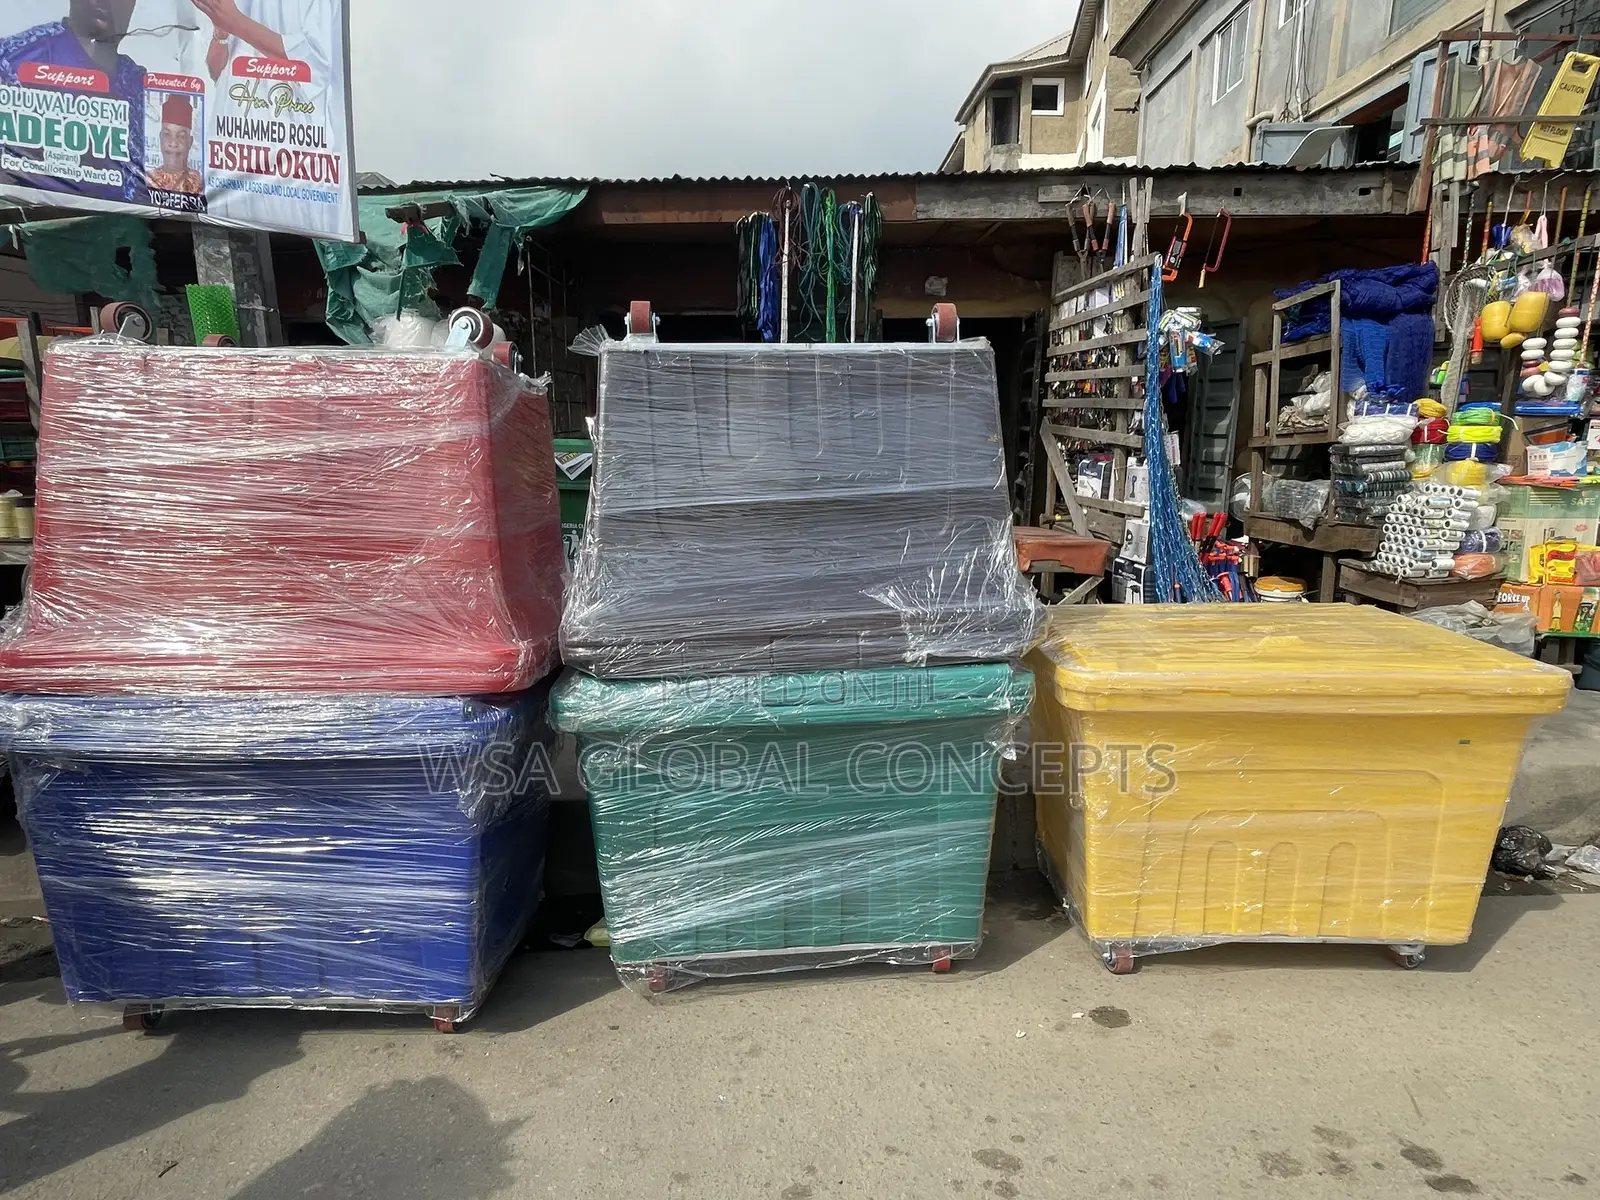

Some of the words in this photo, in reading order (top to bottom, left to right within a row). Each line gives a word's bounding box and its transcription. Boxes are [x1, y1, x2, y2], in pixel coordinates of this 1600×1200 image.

[35, 65, 95, 86] Support
[246, 58, 297, 77] Support
[147, 73, 187, 88] Presented
[190, 79, 201, 91] by
[1559, 83, 1587, 94] CAUTION
[0, 88, 127, 122] OLUWALOSEYI
[0, 112, 129, 158] ADEOYE
[216, 115, 286, 144] MUHAMMED
[289, 123, 328, 149] ROSUL
[1550, 126, 1568, 136] FLOOR
[3, 158, 19, 168] For
[83, 169, 107, 181] Ward
[109, 171, 121, 182] C2
[208, 140, 340, 185] ESHILOKUN
[216, 177, 245, 191] CHAIRMAN
[245, 180, 263, 194] LAGOS
[263, 183, 283, 196] ISLAND
[283, 185, 301, 199] LOCAL
[301, 188, 339, 204] GOVERNMENT
[1570, 497, 1596, 506] SAFE
[1497, 592, 1521, 603] FORCE
